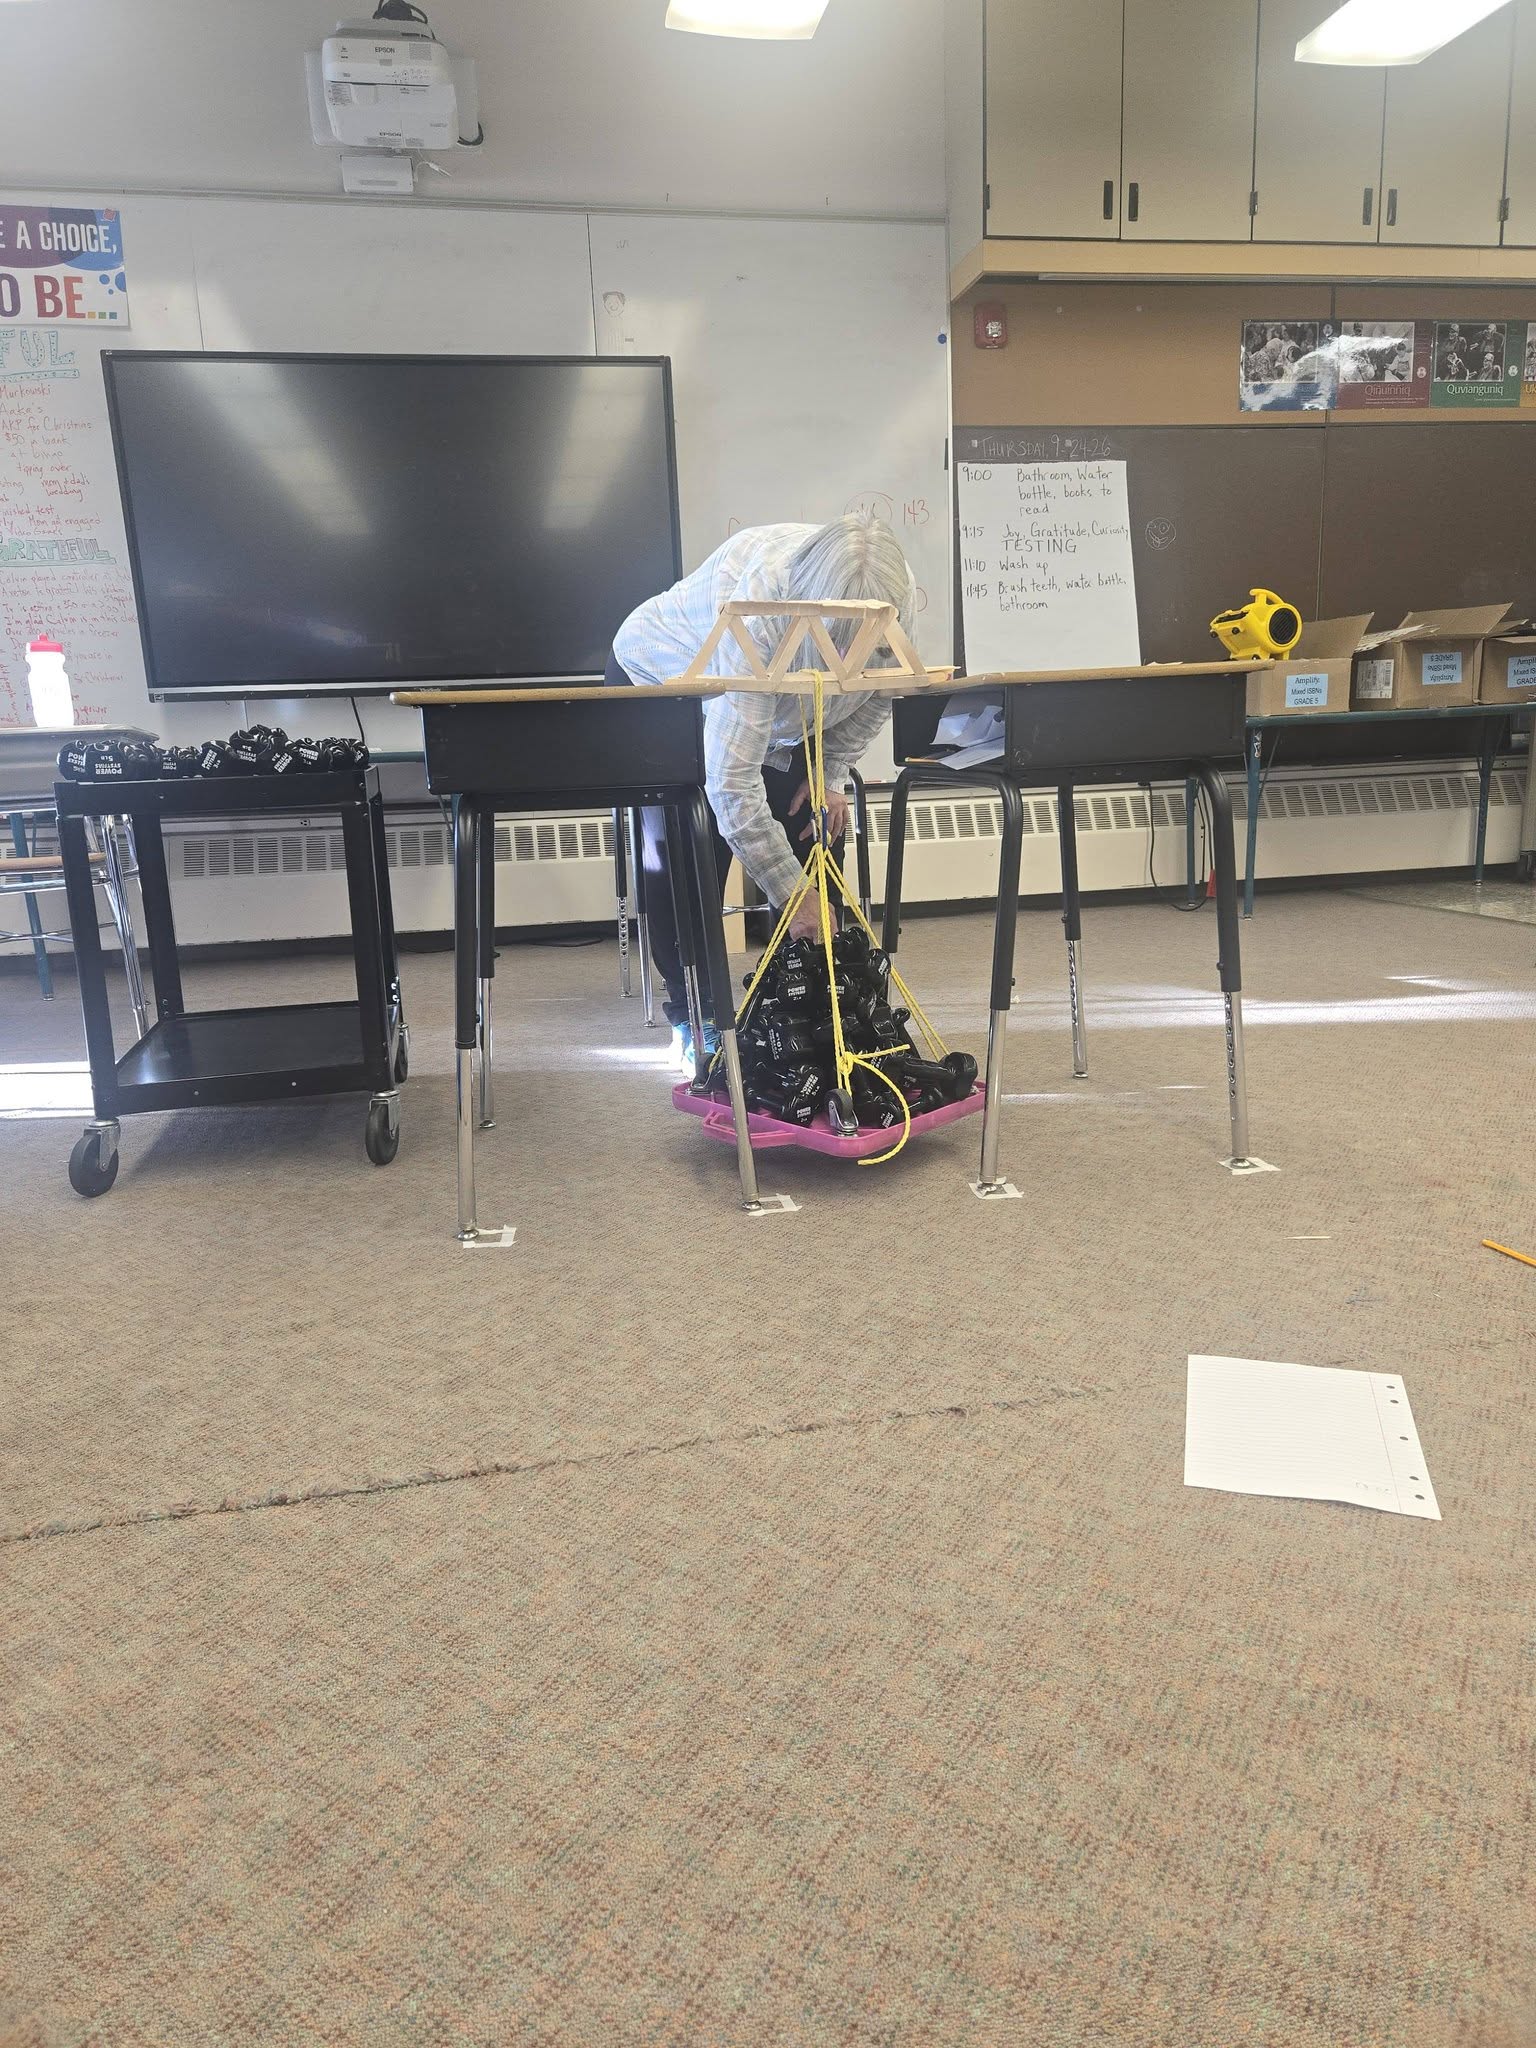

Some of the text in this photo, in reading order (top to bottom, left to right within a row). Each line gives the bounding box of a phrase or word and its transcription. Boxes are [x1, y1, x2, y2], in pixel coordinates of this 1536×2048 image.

[375, 46, 396, 54] EPSON
[16, 220, 32, 250] A
[38, 221, 117, 255] CHOICE,
[43, 416, 92, 431] Christmas
[962, 464, 1113, 483] 9:00 Bathroom, Water
[1019, 483, 1112, 500] bottle, books to
[903, 499, 930, 526] 143
[1019, 503, 1050, 516] read
[65, 511, 102, 532] engaged
[960, 525, 985, 539] 9:15
[1030, 522, 1091, 538] Gratitude,
[1091, 520, 1129, 541] Curiosity
[1001, 538, 1077, 554] TESTING
[964, 556, 1049, 574] 11:10 Wash up
[966, 583, 988, 599] 11:45
[997, 579, 1028, 595] Brush
[1031, 576, 1061, 592] teeth,
[999, 595, 1049, 612] bathroom
[1294, 697, 1314, 705] GRADE
[201, 749, 213, 769] POWER
[299, 747, 319, 757] POWER
[277, 755, 293, 773] POWER
[787, 985, 806, 993] POWER
